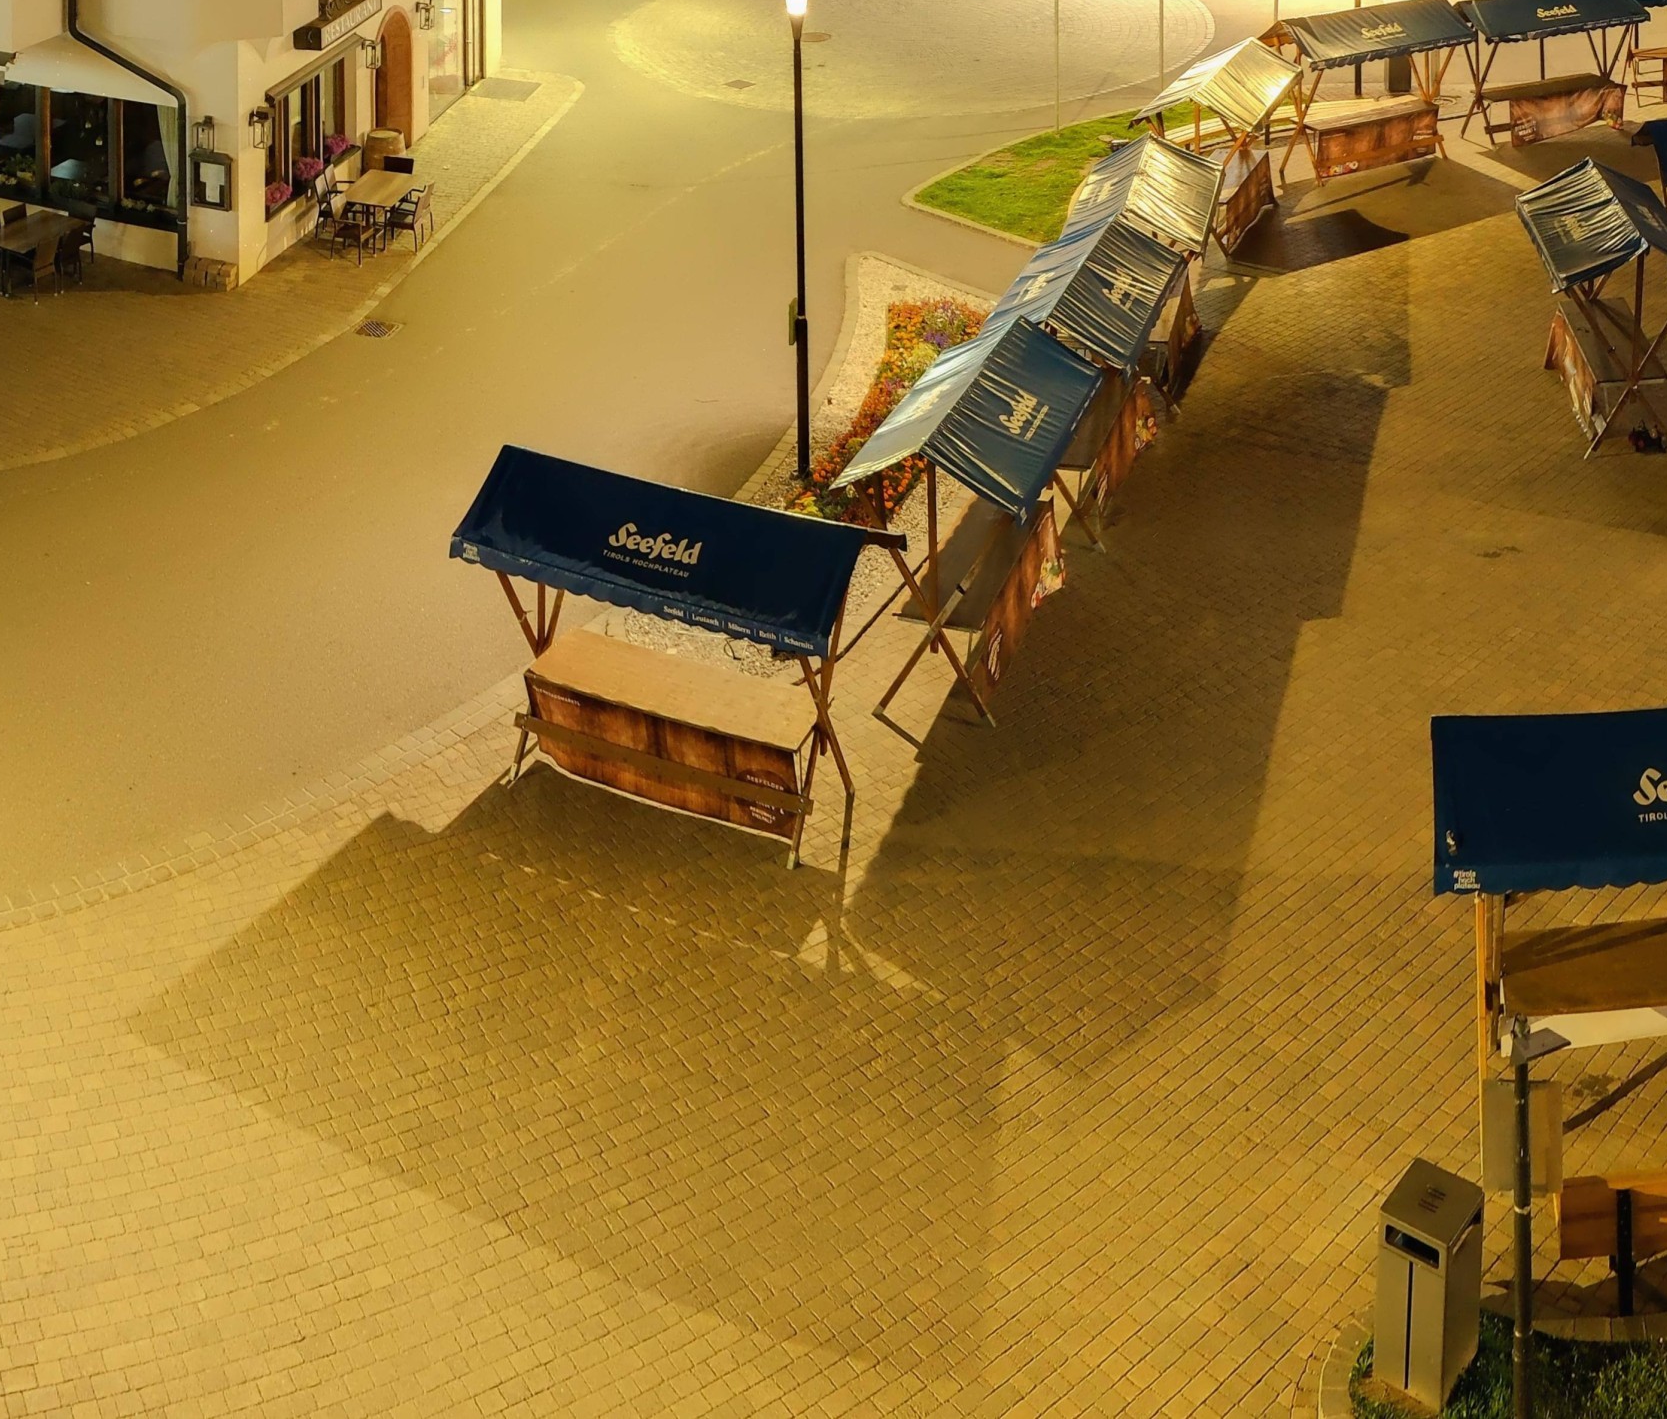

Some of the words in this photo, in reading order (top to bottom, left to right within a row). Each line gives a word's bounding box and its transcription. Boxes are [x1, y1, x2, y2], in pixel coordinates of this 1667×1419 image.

[608, 522, 702, 566] Seefeld
[603, 549, 631, 563] TIROLS
[632, 557, 690, 579] HOCHPLATEAU
